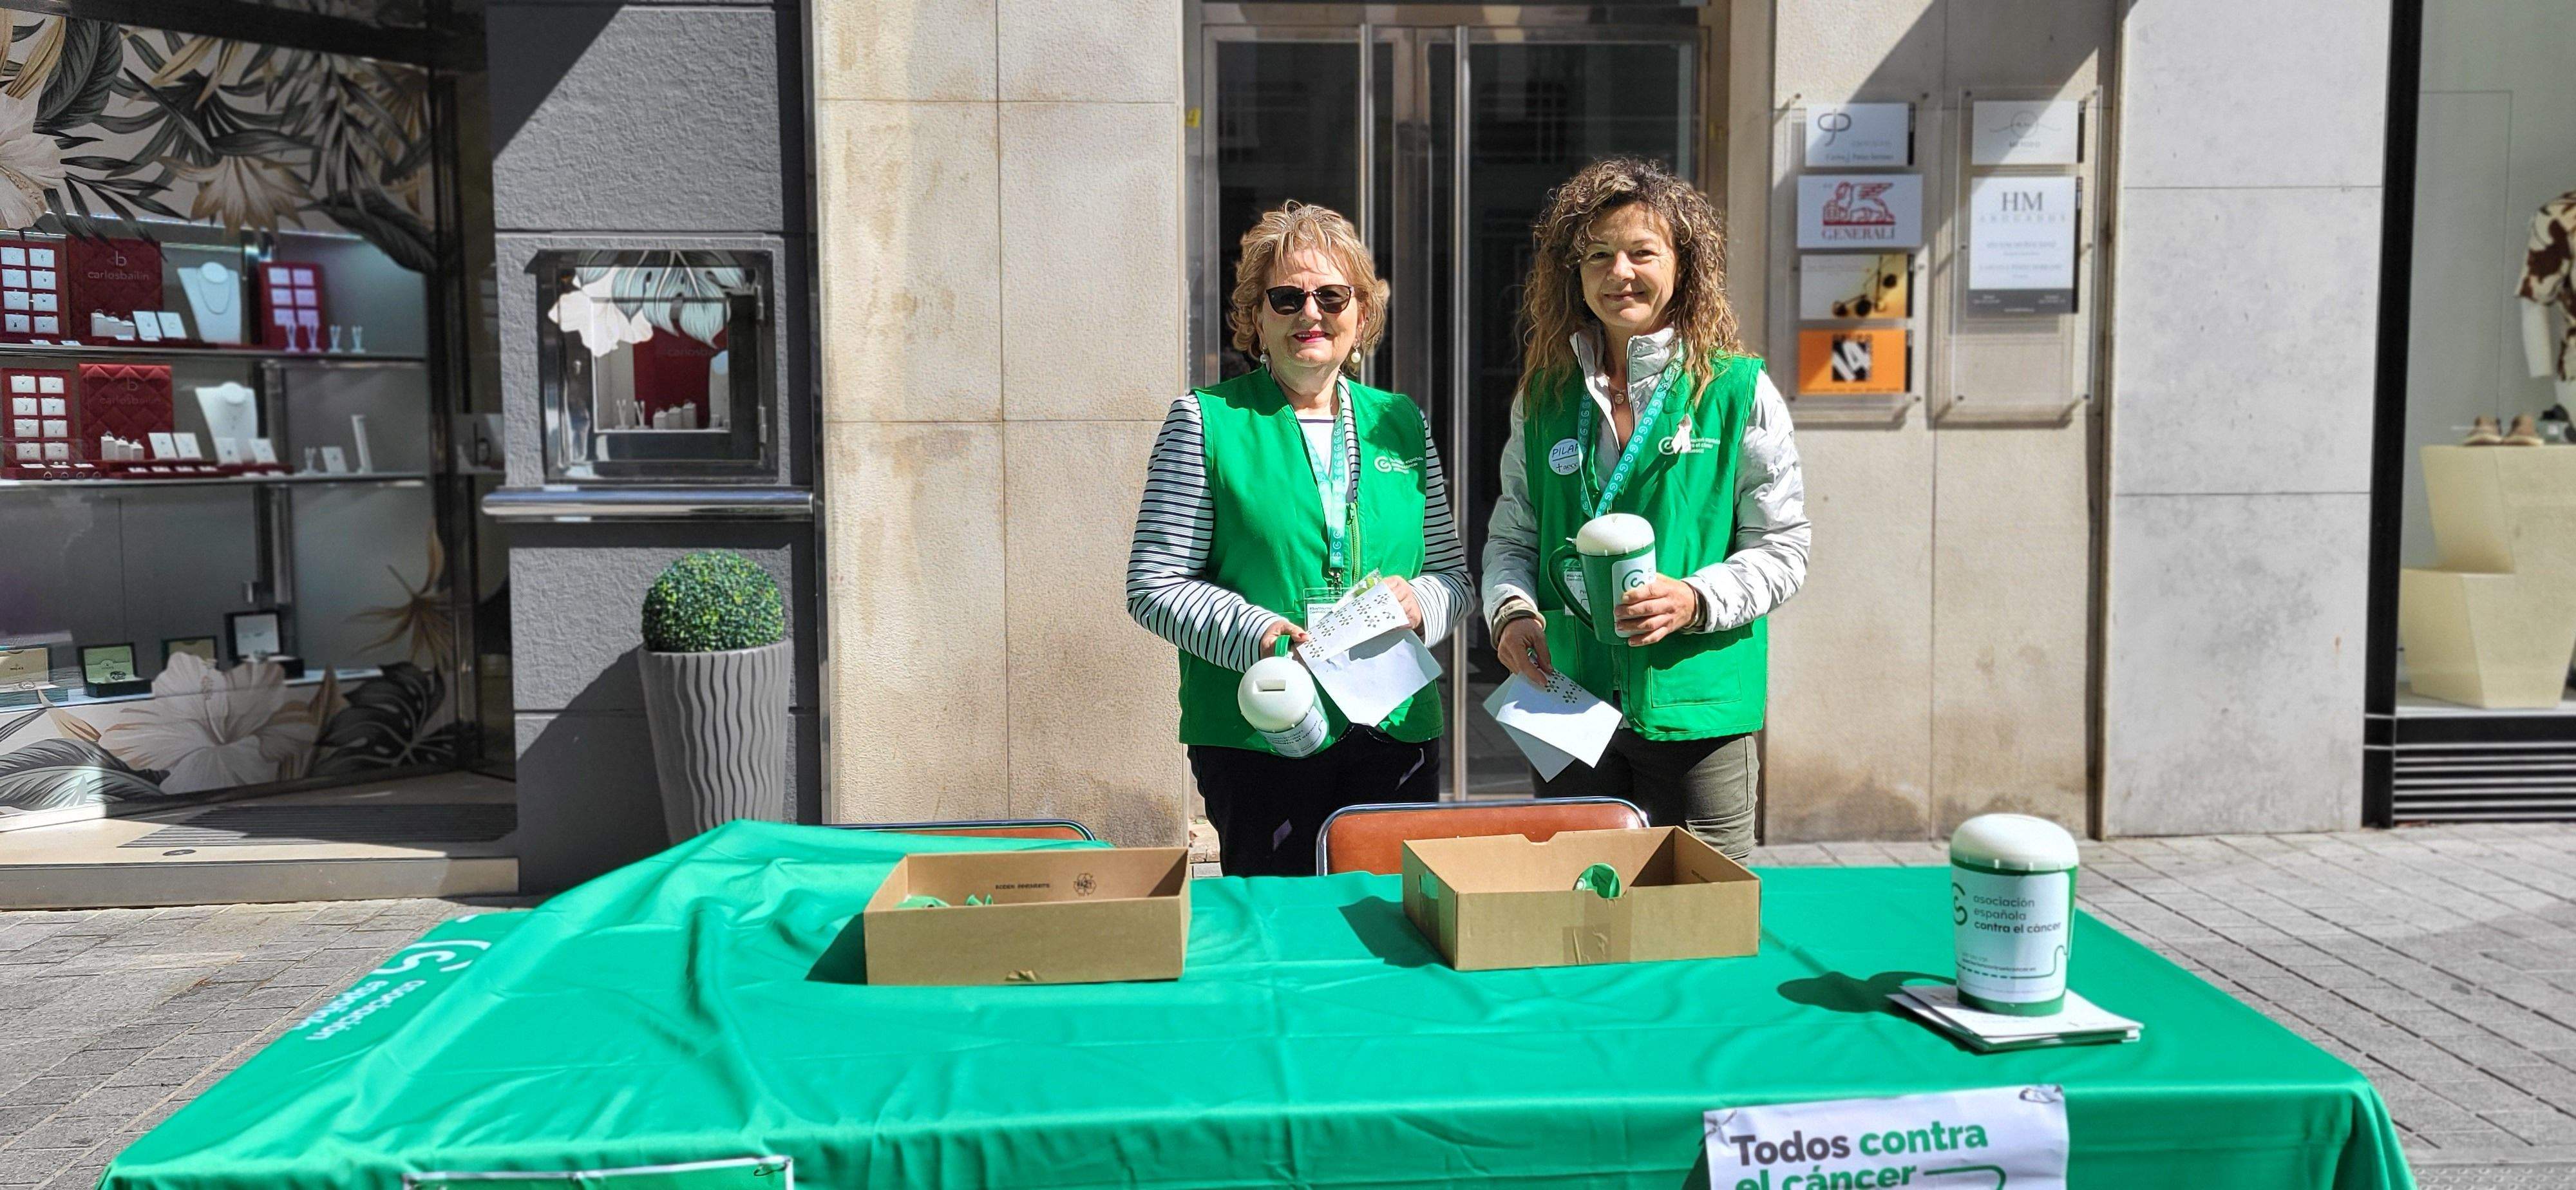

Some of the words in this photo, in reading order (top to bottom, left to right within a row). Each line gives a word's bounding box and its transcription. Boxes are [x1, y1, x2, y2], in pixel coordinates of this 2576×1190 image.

[2002, 191, 2043, 212] HM
[1821, 225, 1895, 241] GENERALI
[1973, 894, 2035, 908] asociación
[1974, 907, 2027, 921] española
[1974, 921, 2011, 933] contra
[2013, 923, 2023, 934] el
[2027, 921, 2061, 934] cáncer
[1730, 1130, 1850, 1166] Todos
[1859, 1120, 1989, 1157] contra
[1735, 1169, 1770, 1190] el
[1782, 1164, 1917, 1190] cáncer
